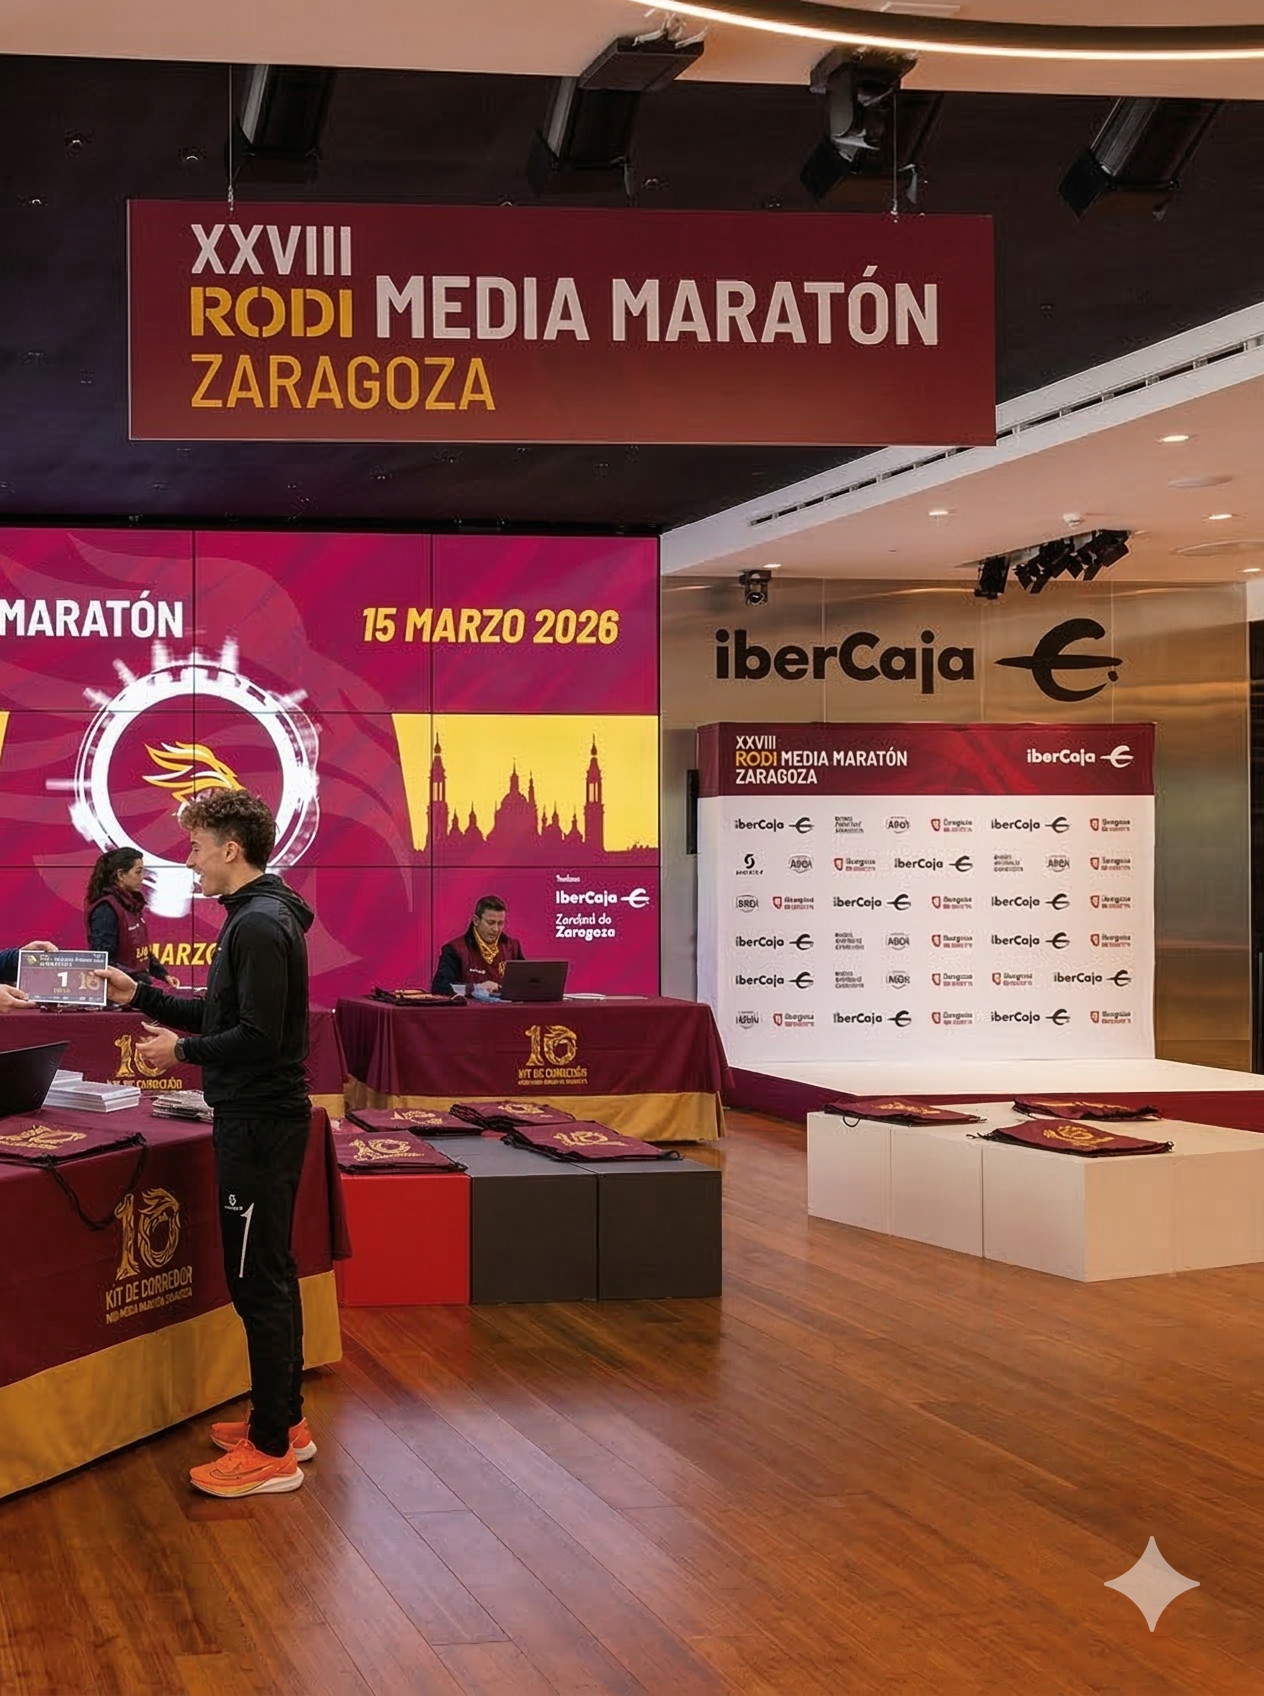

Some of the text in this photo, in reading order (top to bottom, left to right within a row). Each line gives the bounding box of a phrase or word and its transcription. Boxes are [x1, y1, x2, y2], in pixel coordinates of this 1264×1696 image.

[191, 224, 352, 276] XXVIII
[191, 265, 938, 346] RODI MEDIA MARATÓN
[191, 354, 496, 411] ZARAGOZA
[363, 607, 619, 645] 15 MARZO 2026
[715, 629, 976, 695] iberCaja
[735, 735, 776, 749] XXVIII
[735, 747, 908, 767] RODI MEDIA MARATÓN
[735, 769, 818, 784] ZARAGOZA
[555, 925, 616, 942] Zaragoza
[57, 971, 69, 988] 1
[105, 1286, 124, 1311] KIT
[125, 1281, 140, 1303] DE
[141, 1265, 193, 1298] CORREDOR
